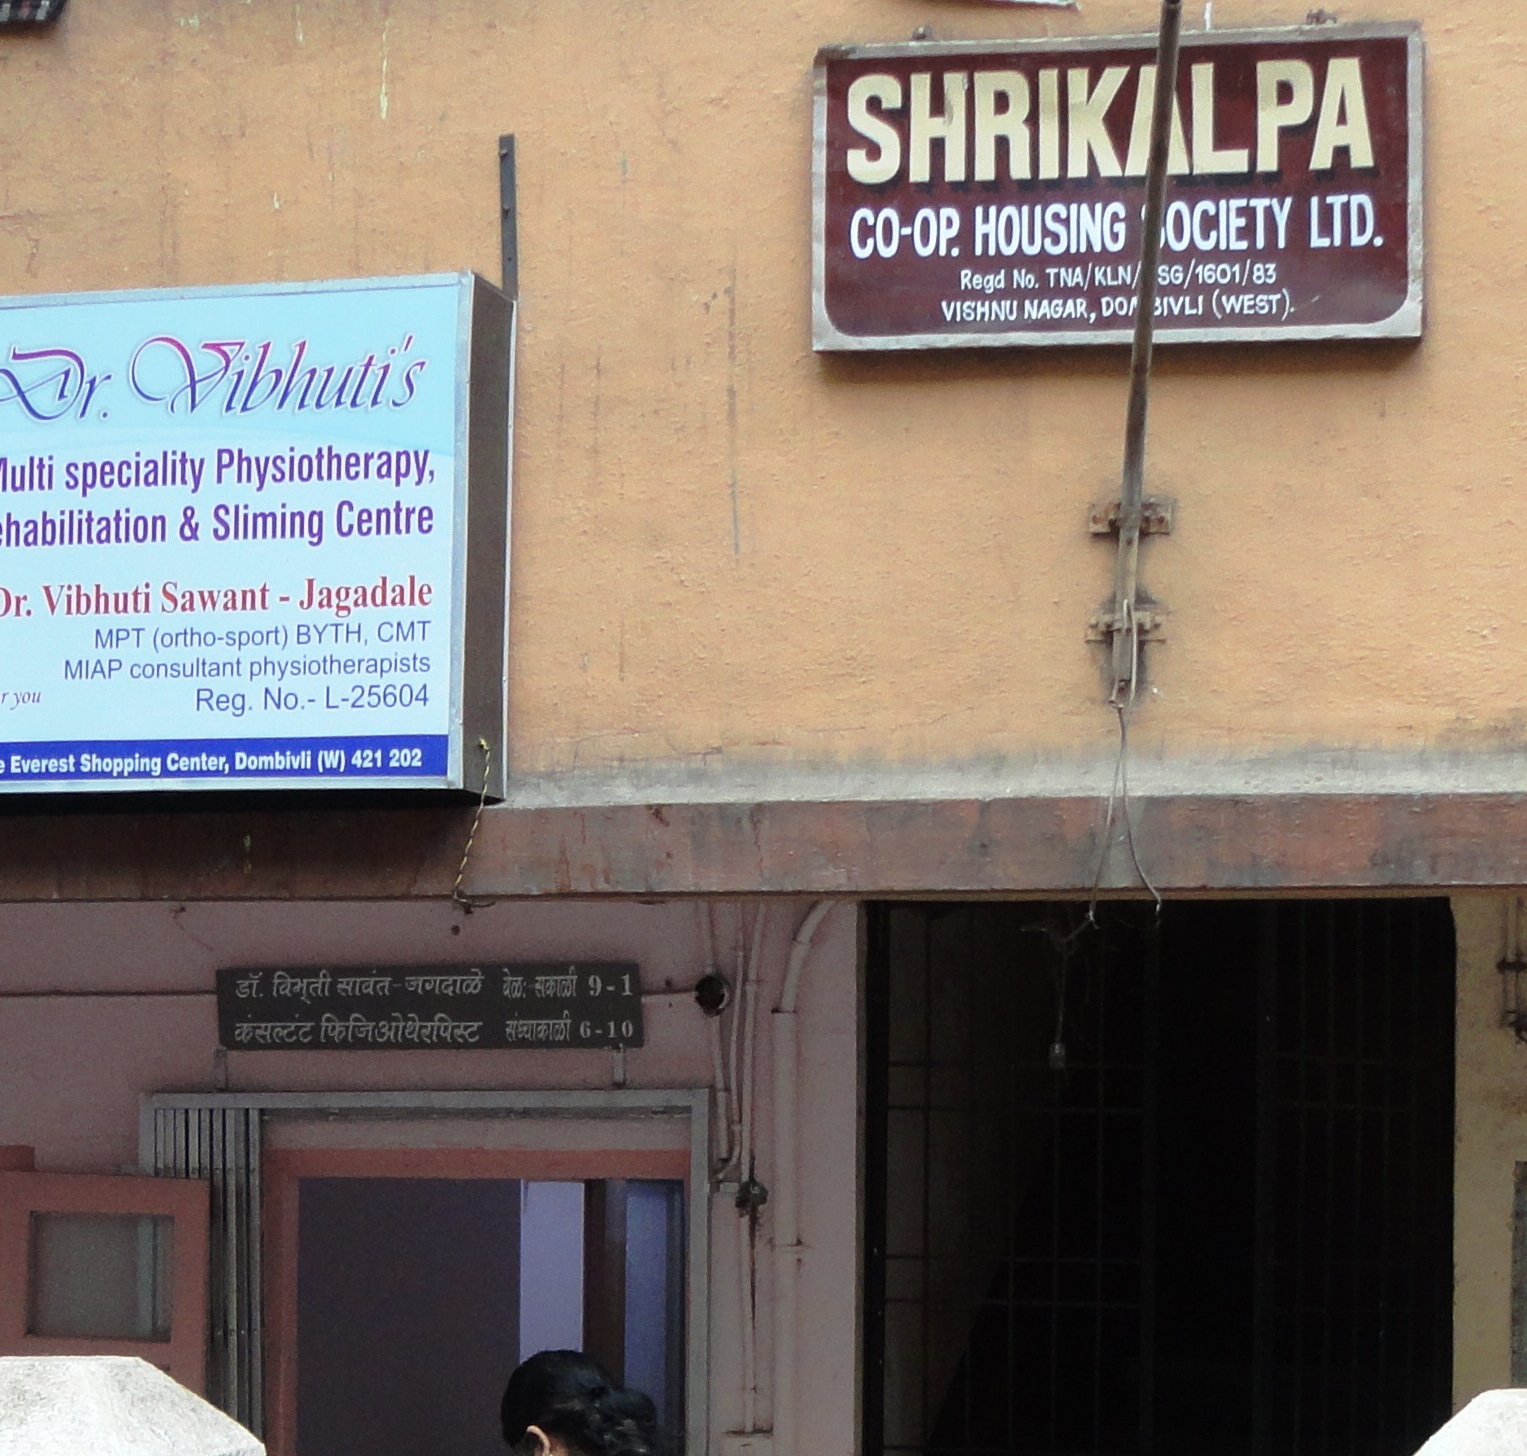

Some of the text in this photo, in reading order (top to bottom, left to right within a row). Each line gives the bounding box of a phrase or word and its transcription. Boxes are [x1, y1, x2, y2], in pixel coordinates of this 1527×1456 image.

[846, 57, 1375, 184] SHRIKALPA
[849, 195, 1384, 260] CO-OP. HOUSING OCIETY LTD.
[960, 258, 1277, 292] Regd No. TNA/KLN/SG/1601/83
[941, 300, 1019, 325] VISHNU
[1023, 298, 1096, 326] NAGAR,
[1212, 288, 1296, 321] (WEST).
[130, 333, 426, 416] Vibhuti's
[65, 451, 205, 498] speciality
[215, 447, 435, 493] Physiotherapy,
[179, 506, 200, 542] &
[212, 502, 324, 547] Sliming
[335, 499, 434, 539] Centre
[42, 582, 152, 616] Vibhuti
[160, 581, 270, 614] Sawant
[298, 575, 433, 618] Jagadale
[94, 620, 432, 653] MPT (ortho-sport) BYTH, CMT
[64, 651, 432, 682] MIAP consultant physiotherapists
[9, 690, 42, 710] you
[195, 683, 430, 717] Reg. No.- L-25604
[10, 754, 75, 774] Everest
[79, 753, 162, 777] Shopping
[166, 752, 229, 775] Center,
[234, 750, 312, 771] Dombivli
[317, 749, 346, 773] (W)
[350, 749, 383, 768] 421
[389, 748, 422, 767] 202
[235, 971, 263, 998] डॉ.
[272, 969, 332, 1004] विभूती
[534, 966, 578, 998] सकाळी
[234, 1014, 315, 1044] कंसल्टंट
